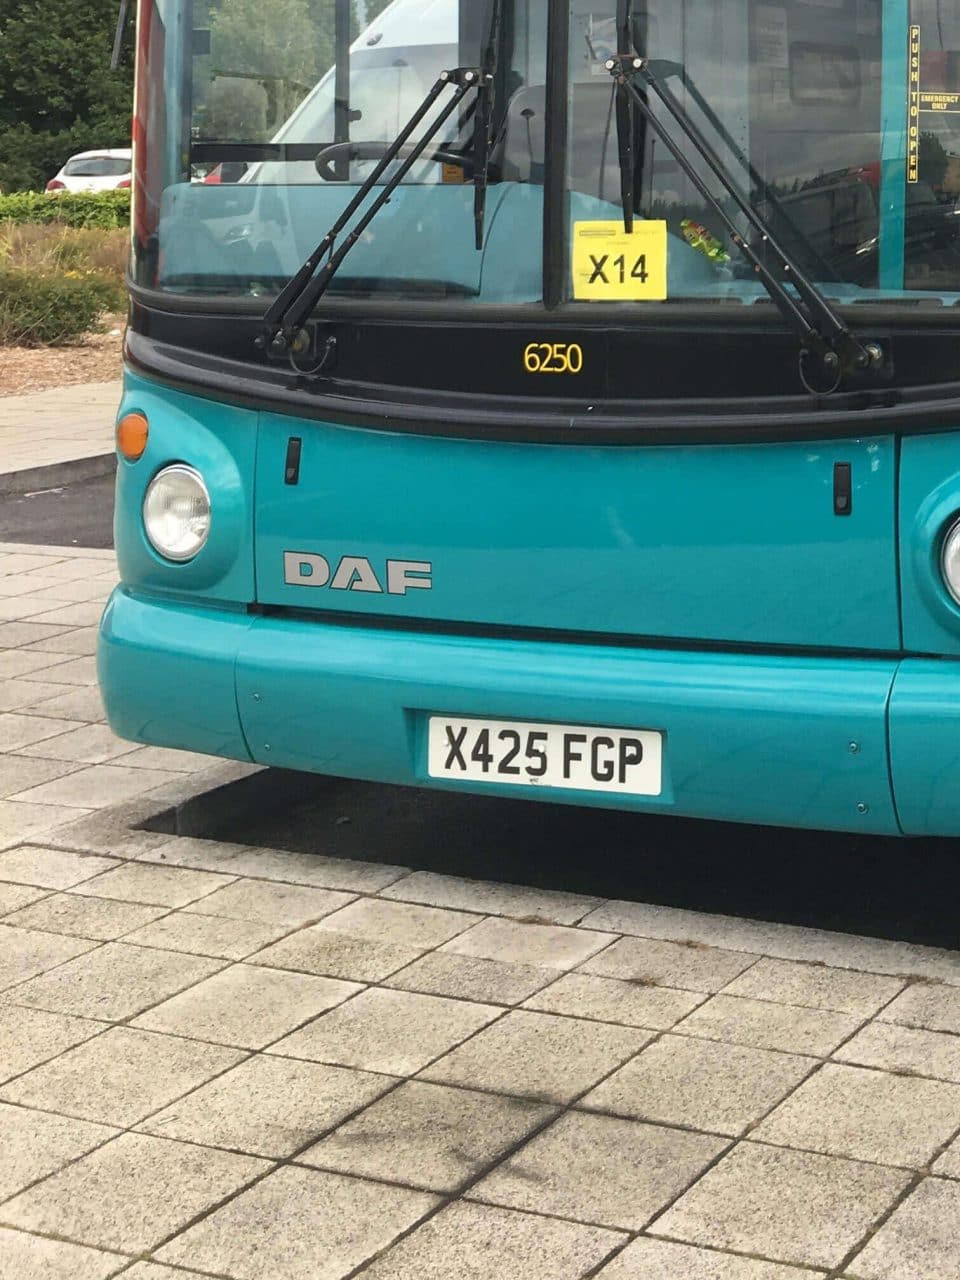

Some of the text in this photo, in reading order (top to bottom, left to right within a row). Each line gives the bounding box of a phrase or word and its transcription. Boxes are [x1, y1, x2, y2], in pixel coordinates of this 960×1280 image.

[910, 92, 918, 116] TO
[920, 95, 959, 103] EMERGENCY
[931, 102, 947, 110] ONLY
[909, 126, 917, 180] OPEN
[588, 254, 648, 284] X14
[524, 342, 583, 373] 6250
[282, 550, 433, 595] DAF
[444, 725, 644, 784] X425 FGP
